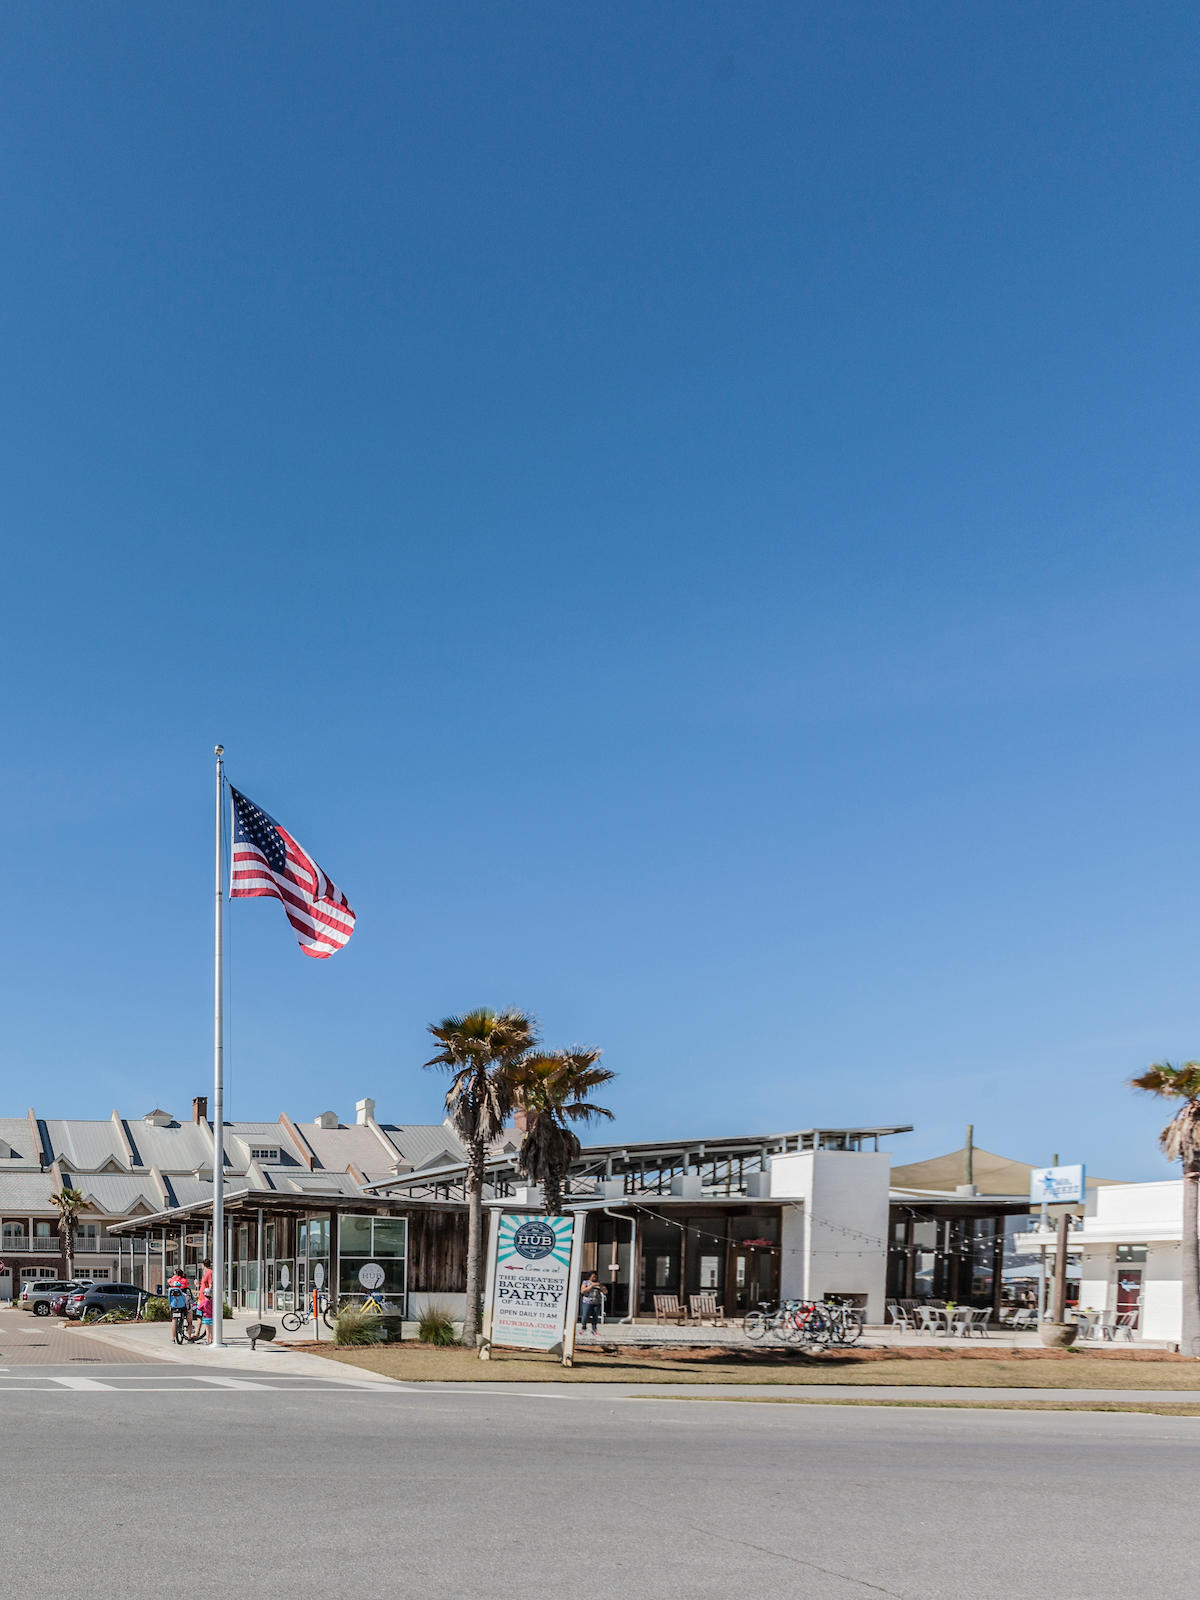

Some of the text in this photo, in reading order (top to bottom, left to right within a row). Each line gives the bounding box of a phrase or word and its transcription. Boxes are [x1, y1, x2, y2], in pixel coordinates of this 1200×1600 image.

[518, 1235, 552, 1246] HUB
[518, 1276, 565, 1284] GREATEST
[499, 1281, 564, 1291] BACKYARD
[498, 1288, 563, 1302] PARTY
[499, 1320, 558, 1329] HUB30A.COM
